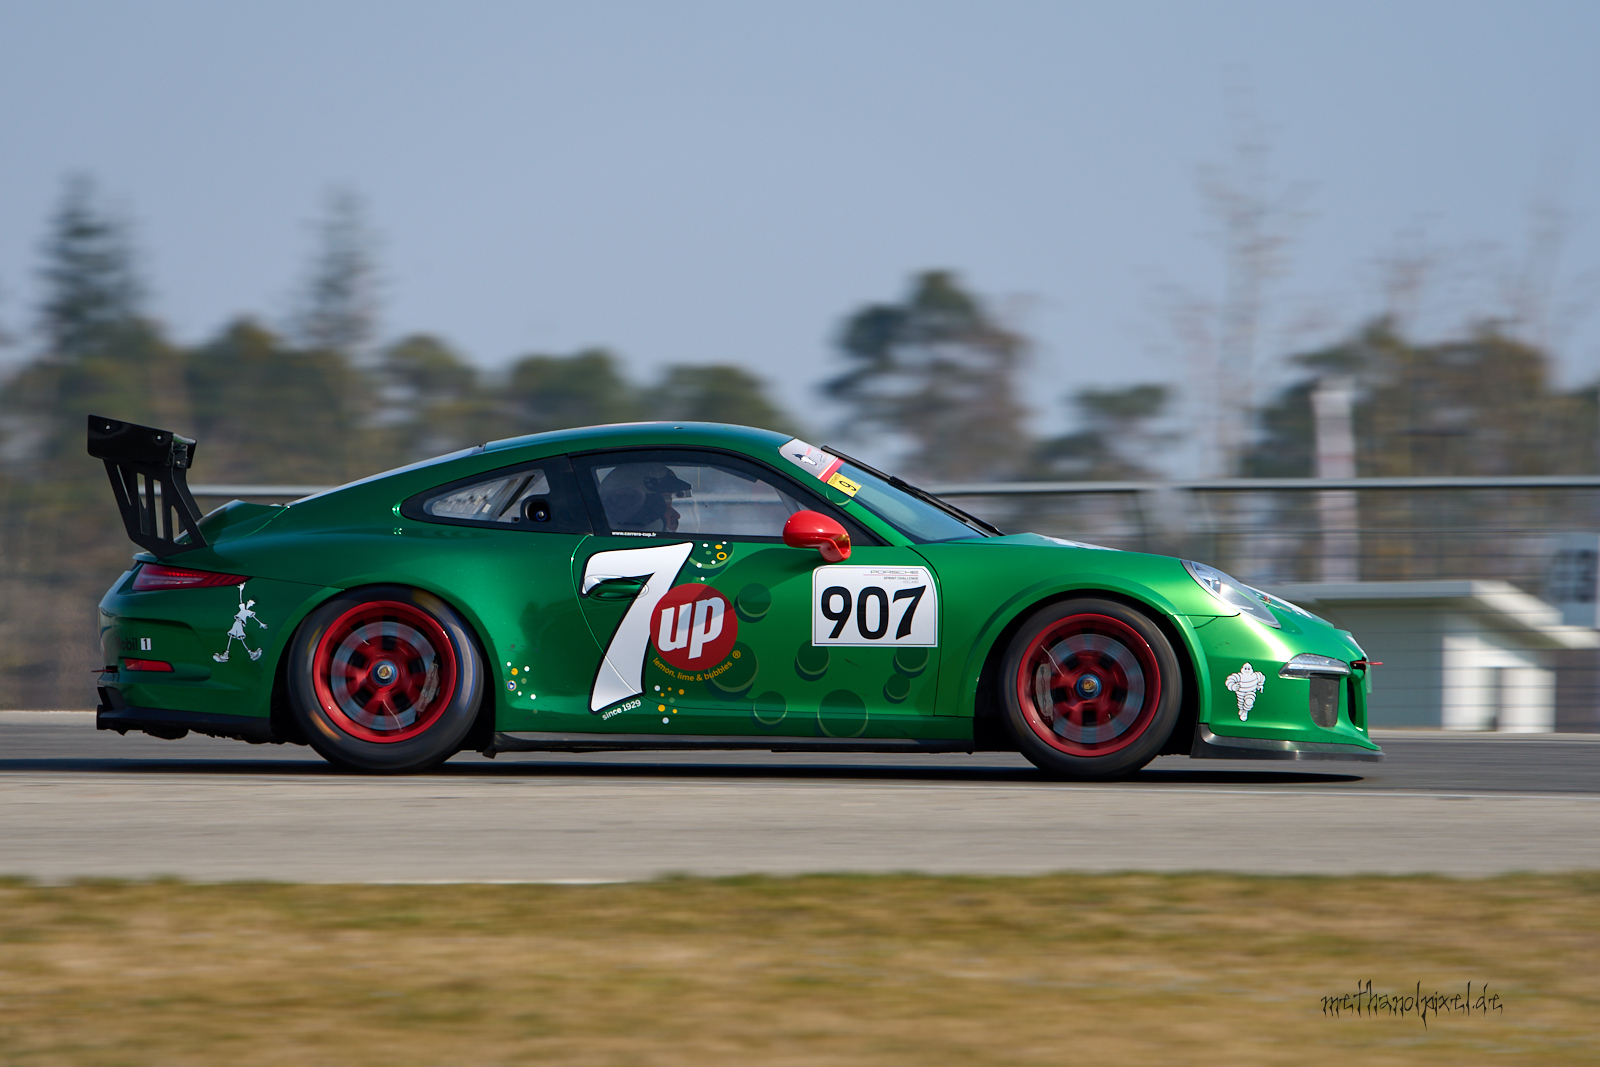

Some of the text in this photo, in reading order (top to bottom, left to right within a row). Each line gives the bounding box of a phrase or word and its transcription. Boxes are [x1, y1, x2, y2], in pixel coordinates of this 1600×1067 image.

[821, 585, 926, 640] 907
[579, 541, 726, 714] 7 up
[142, 638, 149, 650] 1
[653, 657, 676, 678] lemon,
[677, 672, 695, 681] lime
[703, 661, 733, 680] bubbles
[602, 699, 642, 721] since 1929
